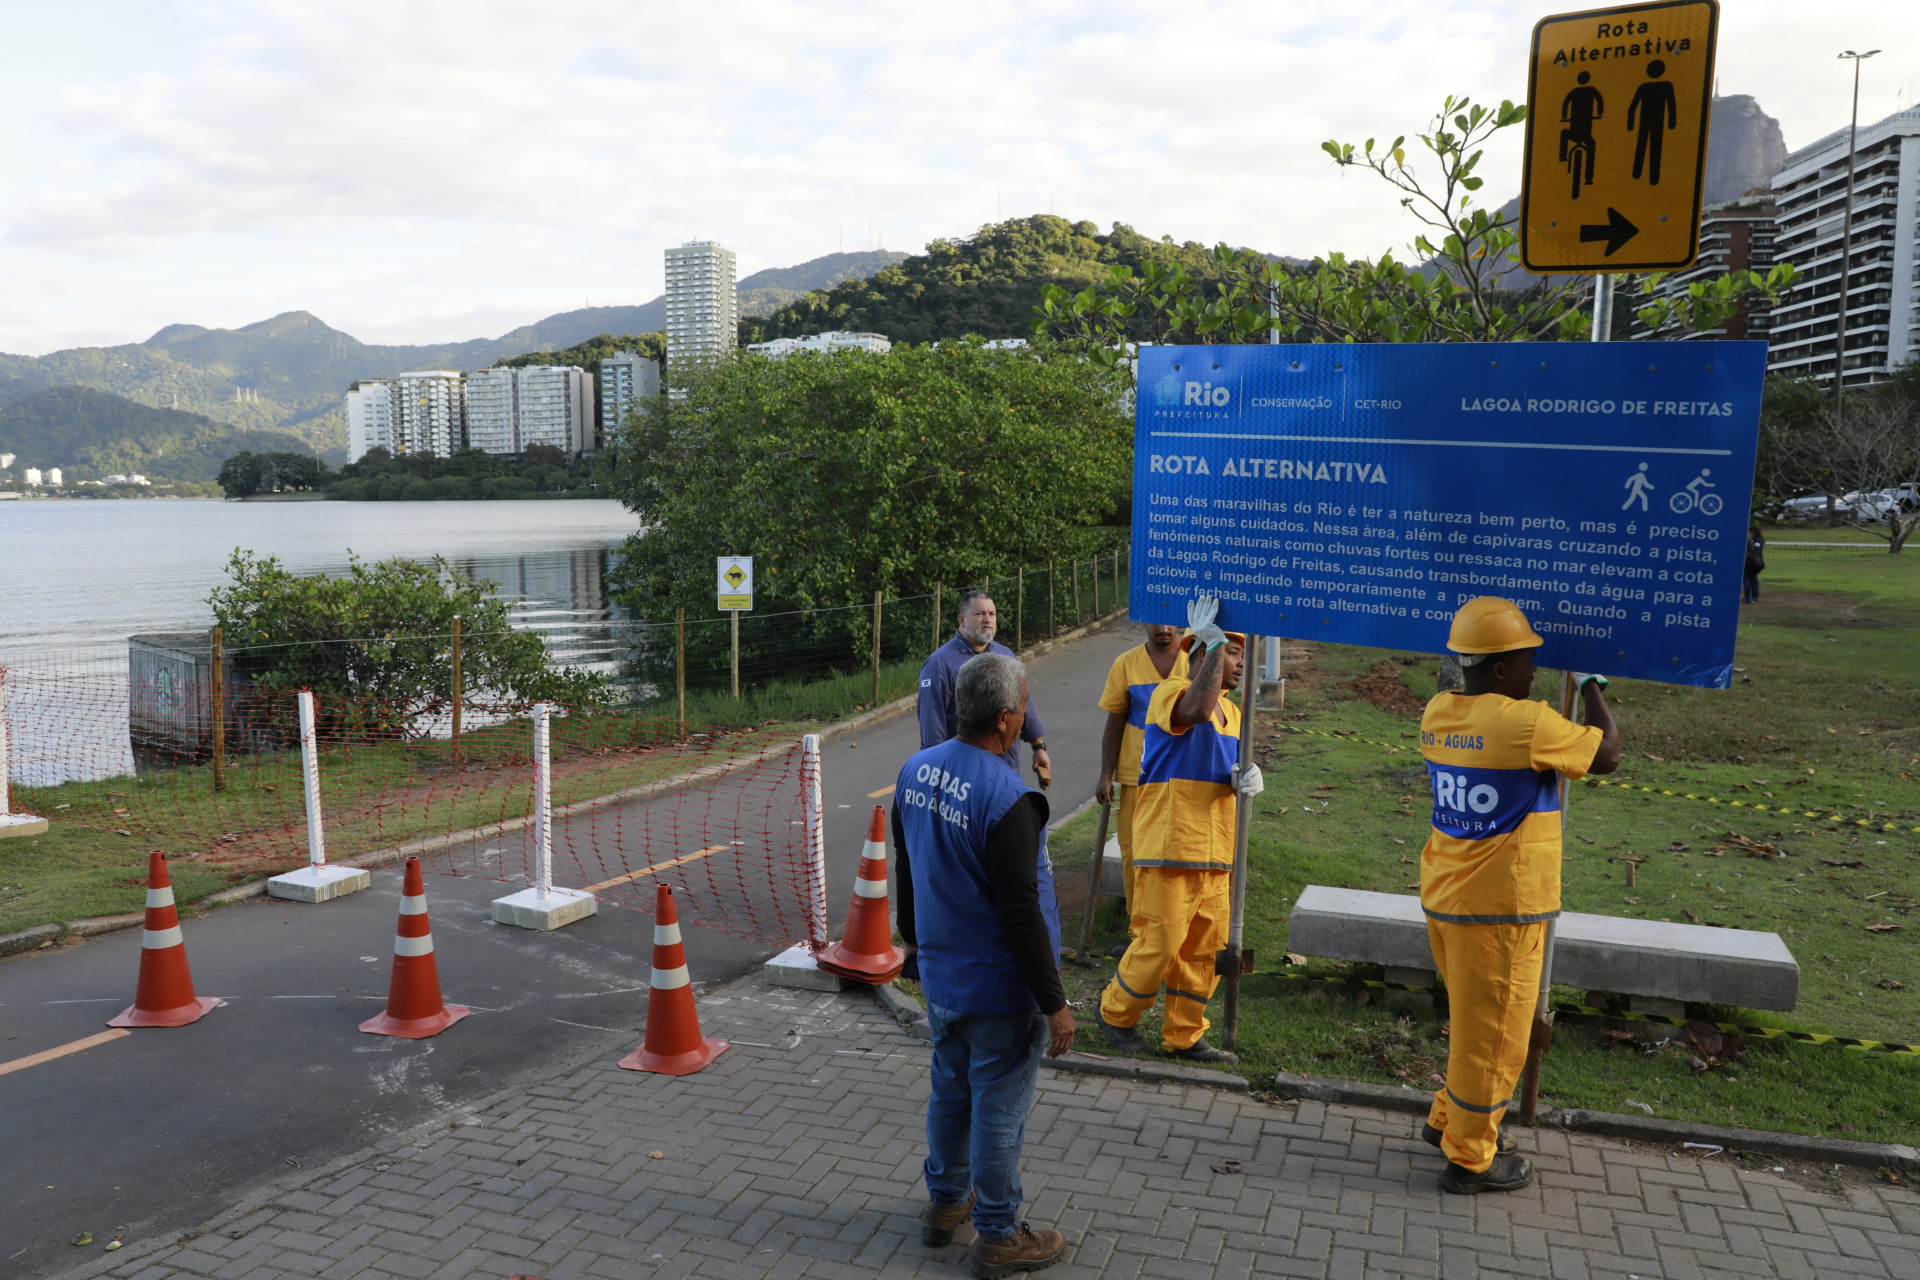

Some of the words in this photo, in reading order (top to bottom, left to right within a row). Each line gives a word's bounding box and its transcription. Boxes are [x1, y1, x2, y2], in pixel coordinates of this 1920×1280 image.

[1597, 20, 1649, 39] Rota
[1553, 37, 1691, 65] Alternativa
[1185, 381, 1230, 406] Rio
[1251, 396, 1332, 410] CONSERVAÇÃO
[1354, 399, 1401, 410] CET-RIO
[1461, 398, 1522, 412] LAGOA
[1527, 398, 1615, 414] RODRIGO
[1622, 400, 1646, 415] DE
[1653, 401, 1733, 416] FREITAS
[1154, 410, 1229, 419] PREFEITURA
[1150, 454, 1211, 476] ROTA
[1222, 457, 1388, 484] ALTERNATIVA
[1150, 493, 1178, 505] Uma
[1184, 495, 1207, 507] das
[1214, 499, 1287, 512] maravilhas
[1294, 501, 1311, 513] do
[1318, 503, 1341, 515] Rio
[1348, 504, 1356, 516] é
[1363, 506, 1383, 518] ter
[1389, 510, 1396, 519] a
[1404, 510, 1471, 523] natureza
[1480, 512, 1514, 526] bem
[1522, 517, 1569, 532] perto,
[1580, 521, 1616, 533] mas
[1627, 521, 1636, 534] é
[1649, 525, 1719, 540] preciso
[1149, 512, 1187, 523] tomar
[1191, 514, 1235, 528] alguns
[1241, 518, 1308, 532] cuidados.
[1314, 521, 1357, 536] Nessa
[1363, 525, 1399, 540] área,
[1405, 528, 1442, 541] além
[1448, 531, 1467, 543] de
[1473, 534, 1552, 549] capivaras
[1559, 541, 1641, 556] cruzando
[1649, 548, 1659, 557] a
[1667, 547, 1717, 564] pista,
[1149, 528, 1221, 544] fenômenos
[1226, 536, 1280, 549] naturais
[1285, 541, 1324, 552] como
[1328, 542, 1380, 556] chuvas
[1385, 545, 1429, 560] fortes
[1434, 552, 1453, 562] ou
[1459, 554, 1522, 568] ressaca
[1527, 559, 1548, 570] no
[1553, 562, 1586, 573] mar
[1591, 562, 1652, 579] elevam
[1658, 570, 1668, 580] a
[1674, 571, 1713, 584] cota
[1148, 546, 1163, 558] da
[1168, 548, 1207, 563] Lagoa
[1213, 551, 1266, 568] Rodrigo
[1271, 556, 1287, 568] de
[1293, 557, 1344, 575] Freitas,
[1350, 565, 1423, 579] causando
[1429, 569, 1569, 592] transbordamento
[1575, 581, 1595, 595] da
[1602, 583, 1644, 601] água
[1654, 591, 1693, 604] para
[1702, 596, 1712, 606] a
[1147, 583, 1190, 595] estiver
[1194, 585, 1250, 604] fechada,
[1256, 594, 1280, 604] use
[1284, 596, 1292, 605] a
[1297, 597, 1324, 608] rota
[1329, 599, 1406, 616] alternativa
[1412, 609, 1420, 618] e
[1534, 620, 1612, 638] caminho!
[1148, 565, 1196, 578] ciclovia
[1205, 571, 1211, 580] e
[1220, 570, 1292, 587] impedindo
[1301, 577, 1426, 599] temporariamente
[1437, 592, 1445, 601] a
[1558, 600, 1626, 619] Quando
[1641, 612, 1651, 622] a
[1665, 612, 1710, 628] pista
[1421, 730, 1435, 746] RIO
[1444, 731, 1484, 750] ÁGUAS
[917, 763, 972, 802] OBRAS
[1436, 771, 1499, 814] Rio
[905, 788, 926, 808] RIO
[927, 792, 970, 830] ÁGUAS
[1435, 811, 1497, 831] FEITURA
